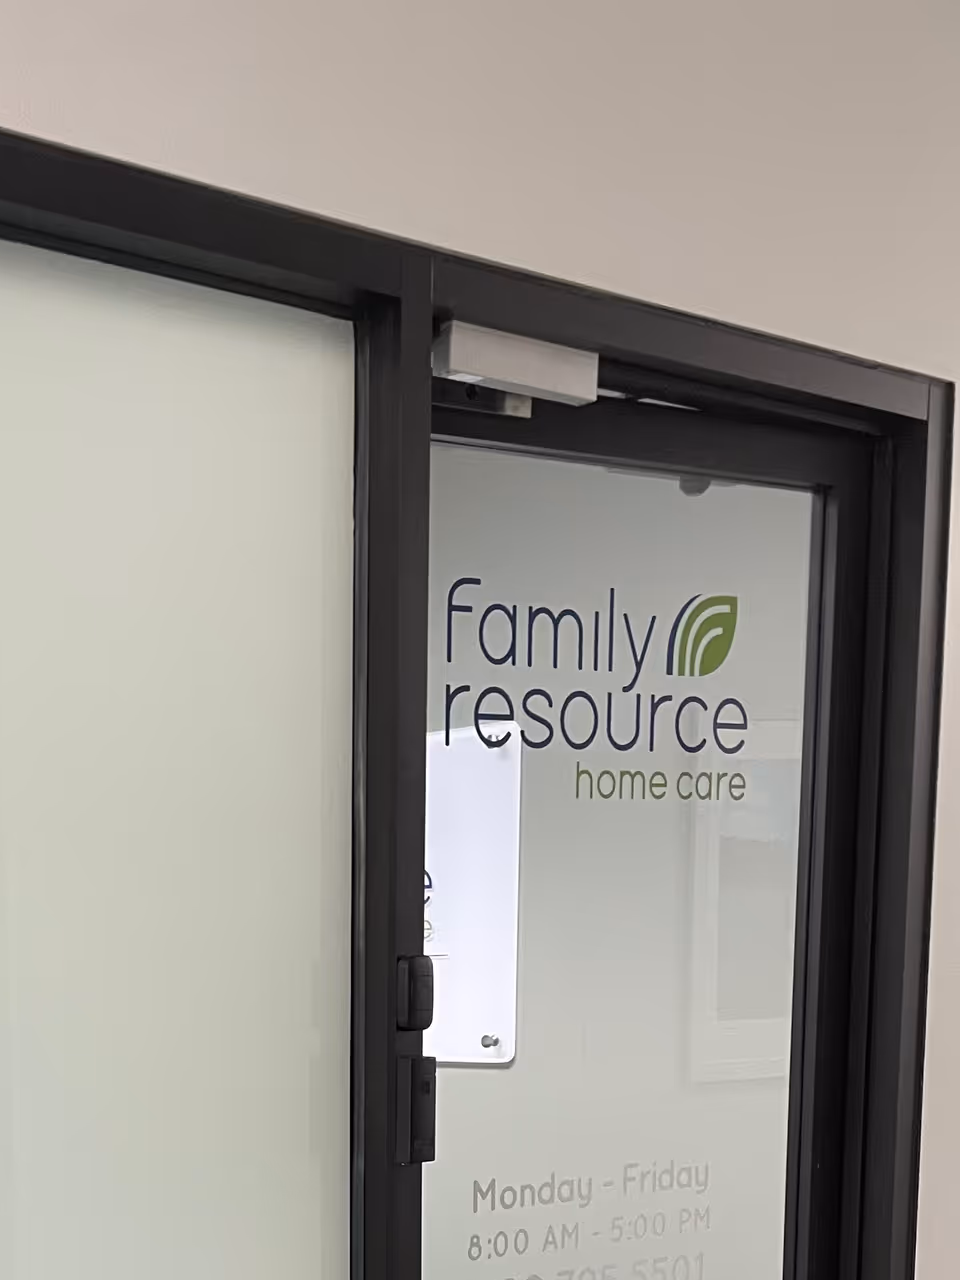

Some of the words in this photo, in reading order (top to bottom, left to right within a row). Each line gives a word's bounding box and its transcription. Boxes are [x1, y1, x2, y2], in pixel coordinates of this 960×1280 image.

[446, 576, 657, 693] family
[444, 683, 749, 755] resource
[575, 761, 668, 800] home
[676, 770, 747, 801] care
[472, 1171, 593, 1214] Monday
[623, 1159, 710, 1198] Friday
[467, 1228, 529, 1261] 8:00
[542, 1222, 580, 1253] AM
[610, 1212, 666, 1243] 5:00
[679, 1203, 711, 1234] PM
